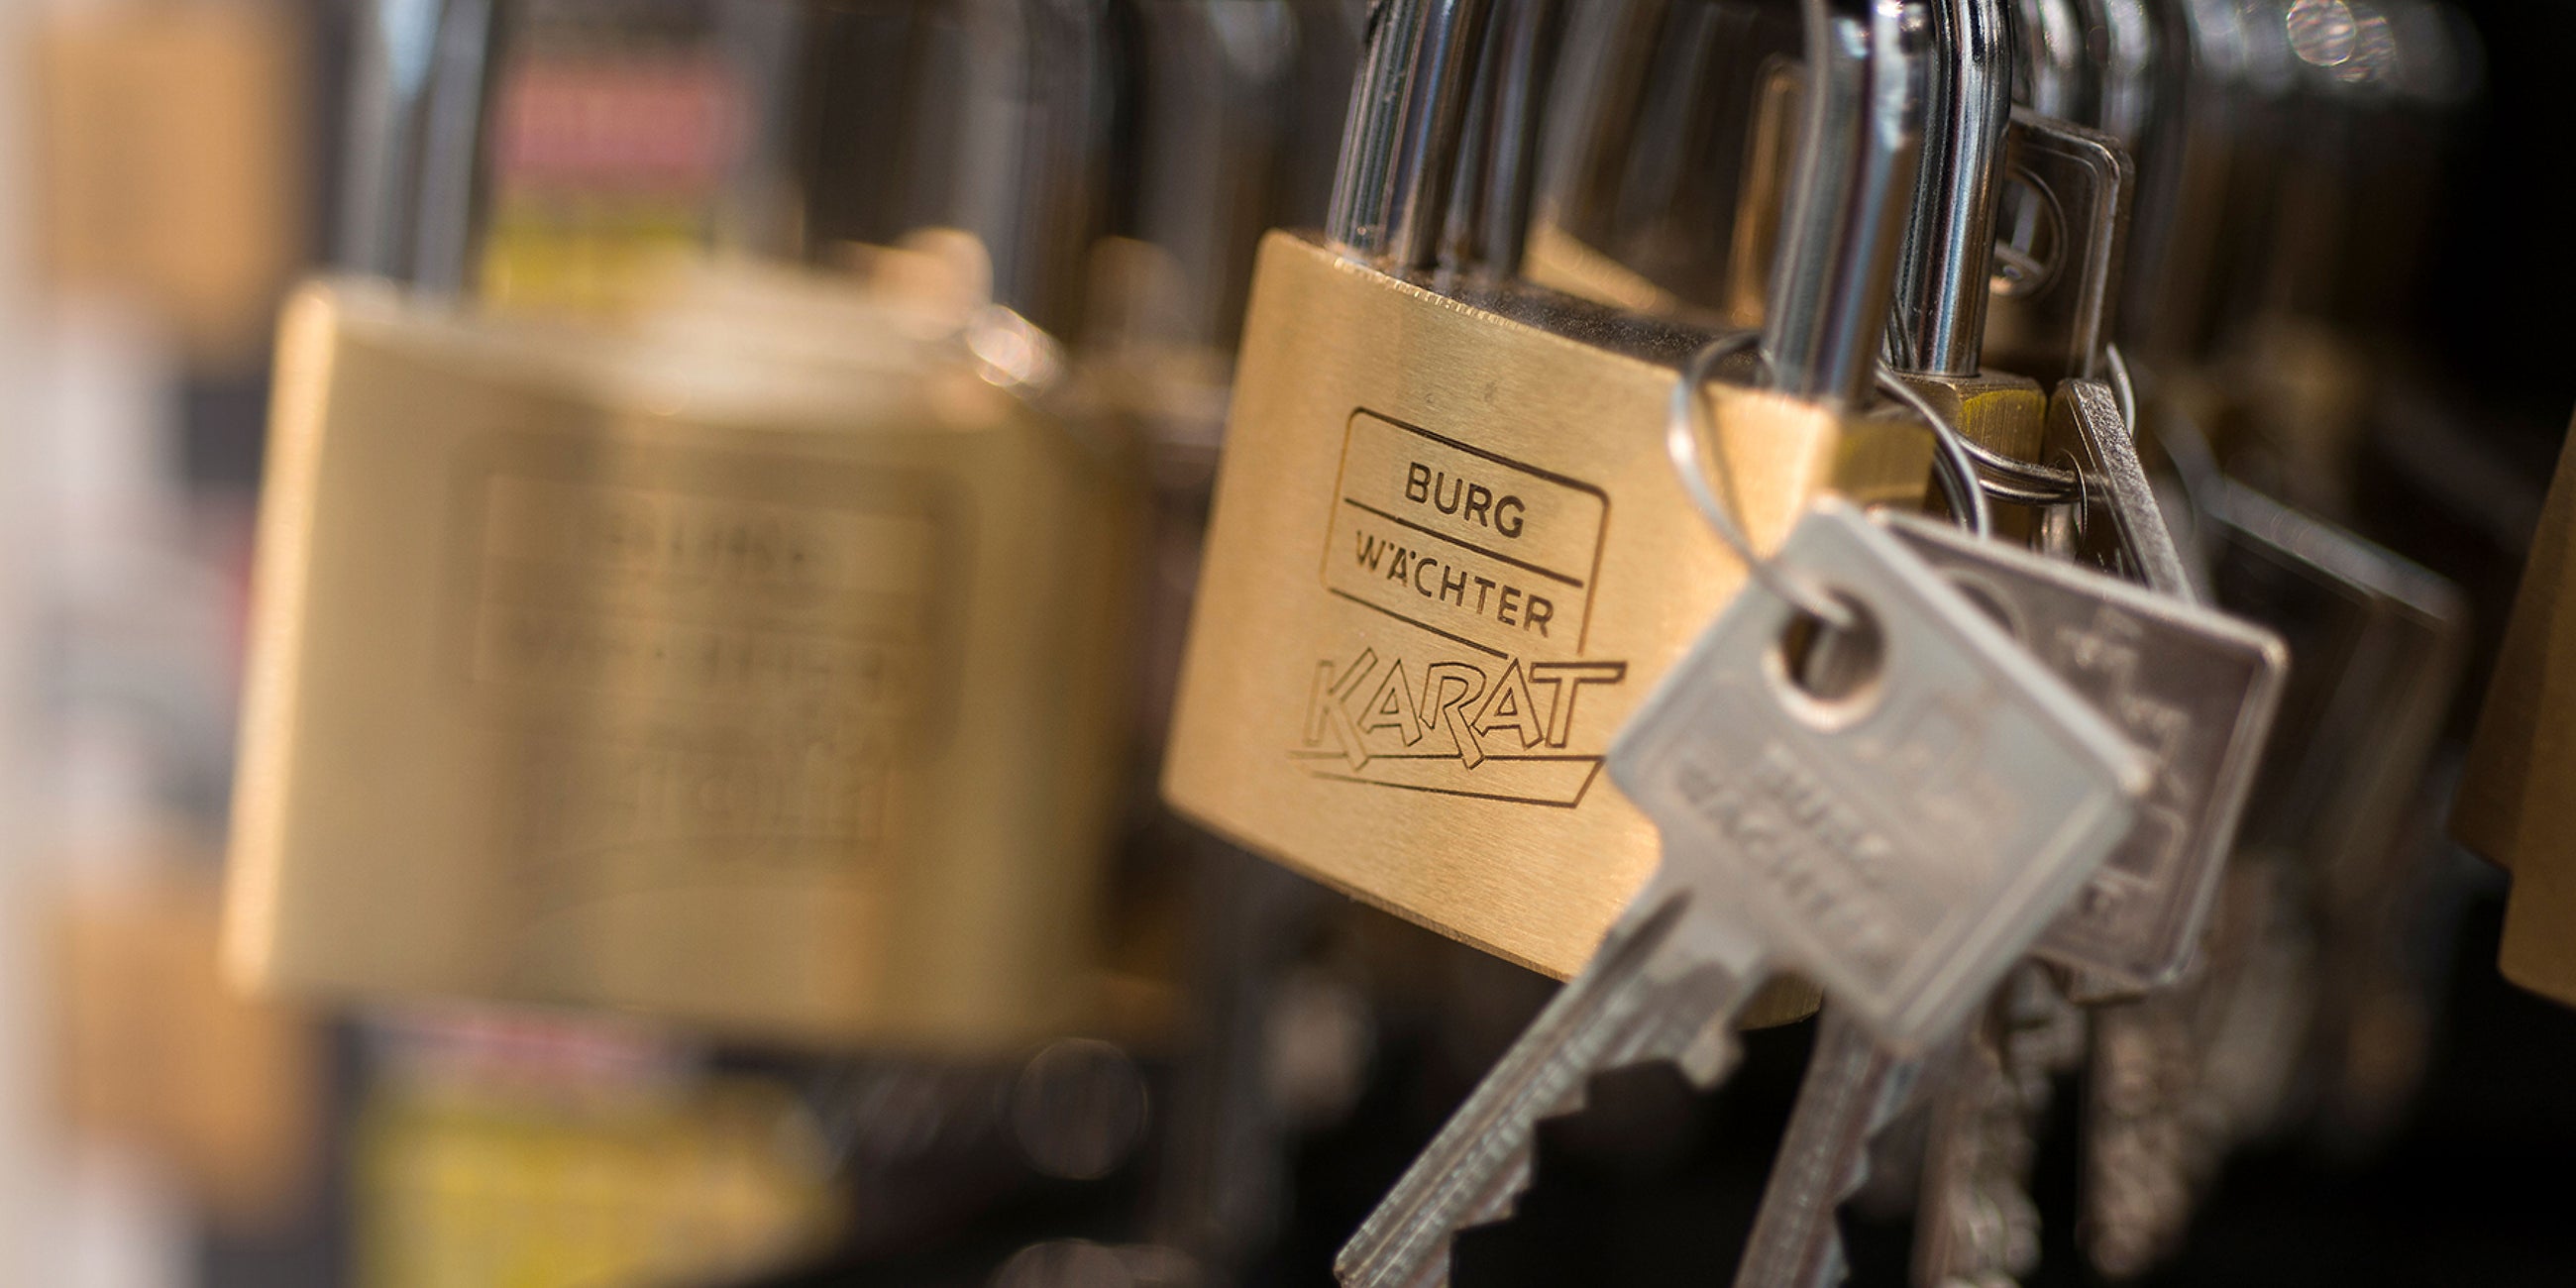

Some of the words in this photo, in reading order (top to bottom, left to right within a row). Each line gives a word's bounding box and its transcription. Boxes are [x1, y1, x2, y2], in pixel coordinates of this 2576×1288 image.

[1404, 461, 1526, 539] BURG
[1355, 529, 1556, 638] WÄCHTER
[1302, 646, 1628, 772] KARAT
